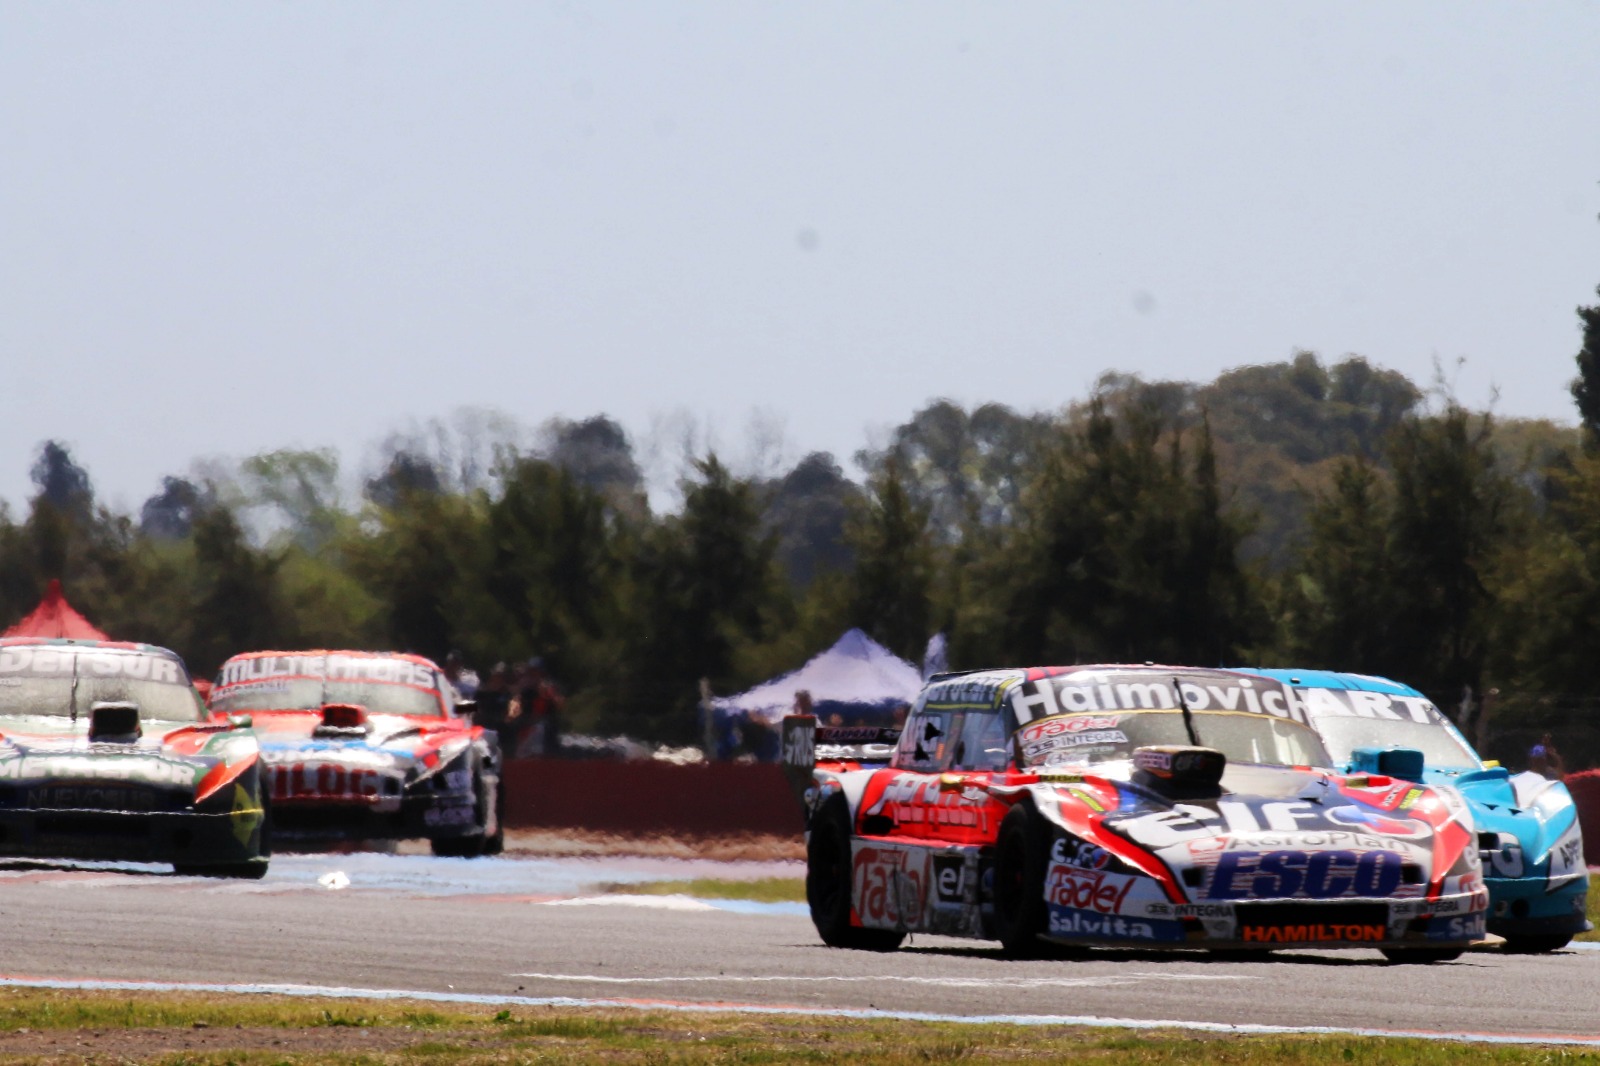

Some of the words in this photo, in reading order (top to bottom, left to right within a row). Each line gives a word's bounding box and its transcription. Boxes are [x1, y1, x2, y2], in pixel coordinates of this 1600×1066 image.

[1011, 678, 1312, 727] Haimovich
[1049, 911, 1154, 939] Salvita
[1242, 924, 1386, 943] HAMILTON
